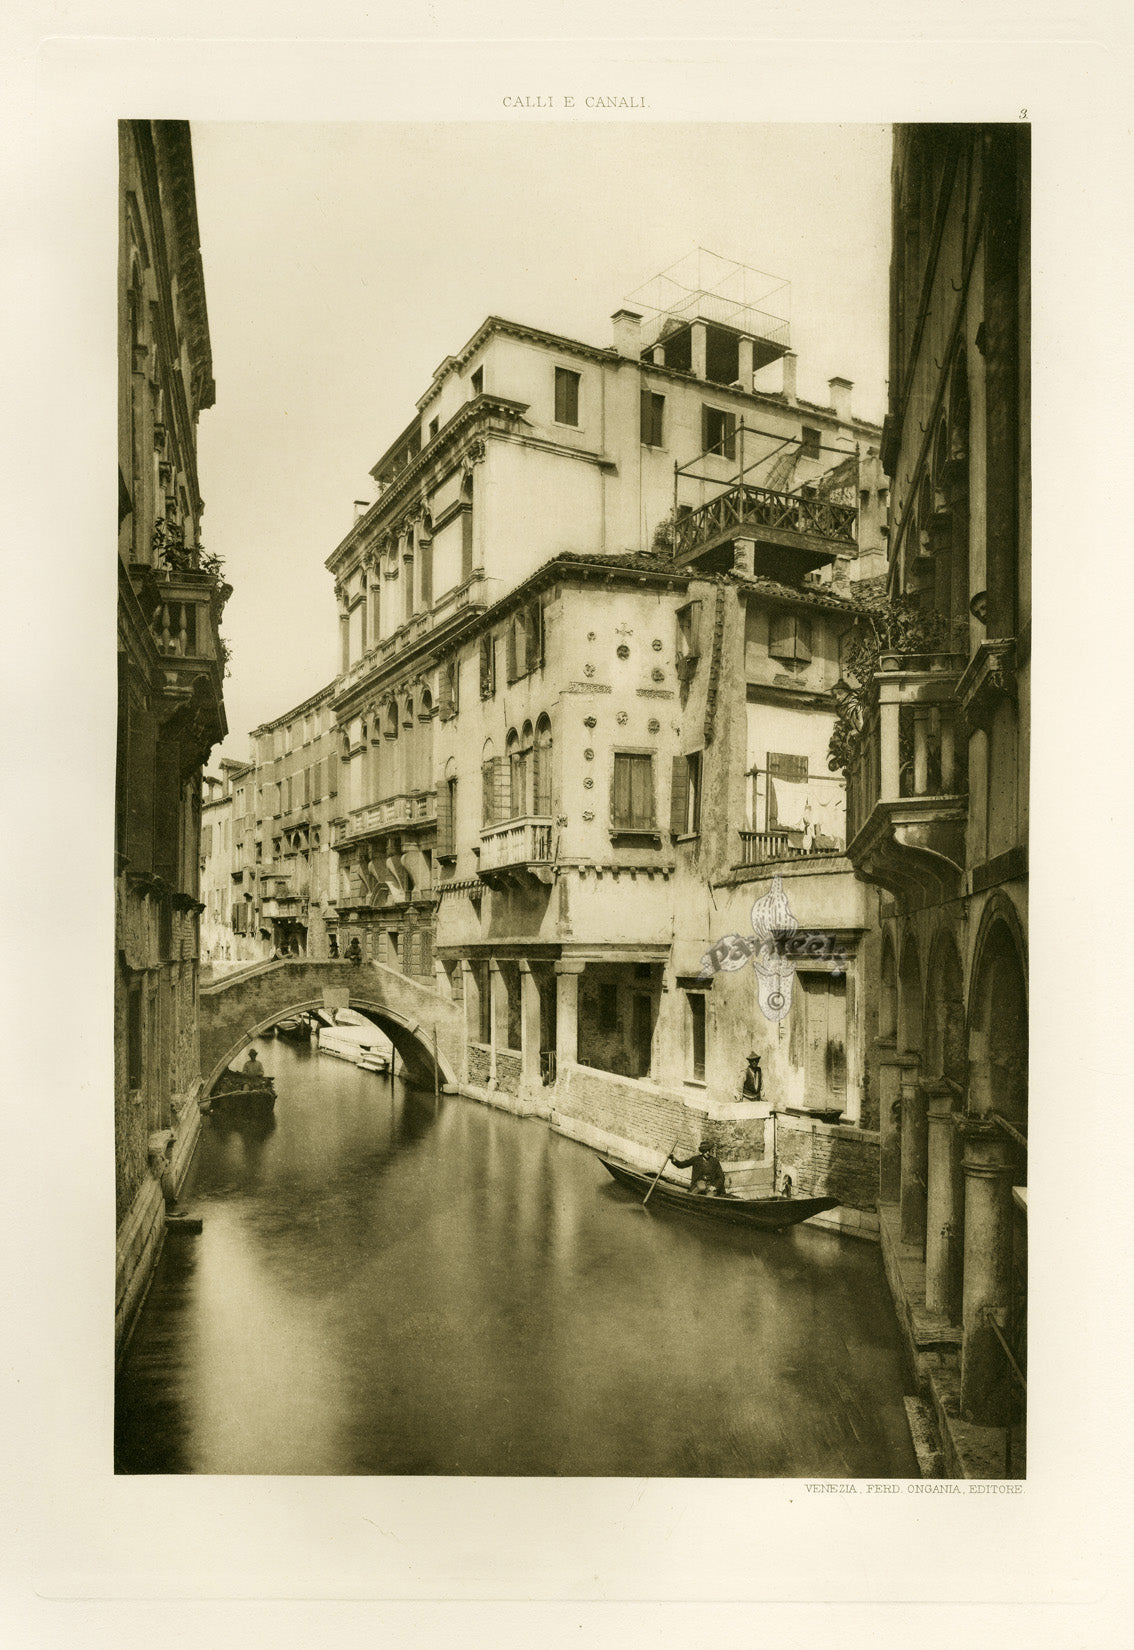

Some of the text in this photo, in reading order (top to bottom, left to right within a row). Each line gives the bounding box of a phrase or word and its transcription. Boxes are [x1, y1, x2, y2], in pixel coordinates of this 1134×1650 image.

[502, 96, 651, 108] CALLI E CANALI.
[866, 1483, 904, 1494] FERD.
